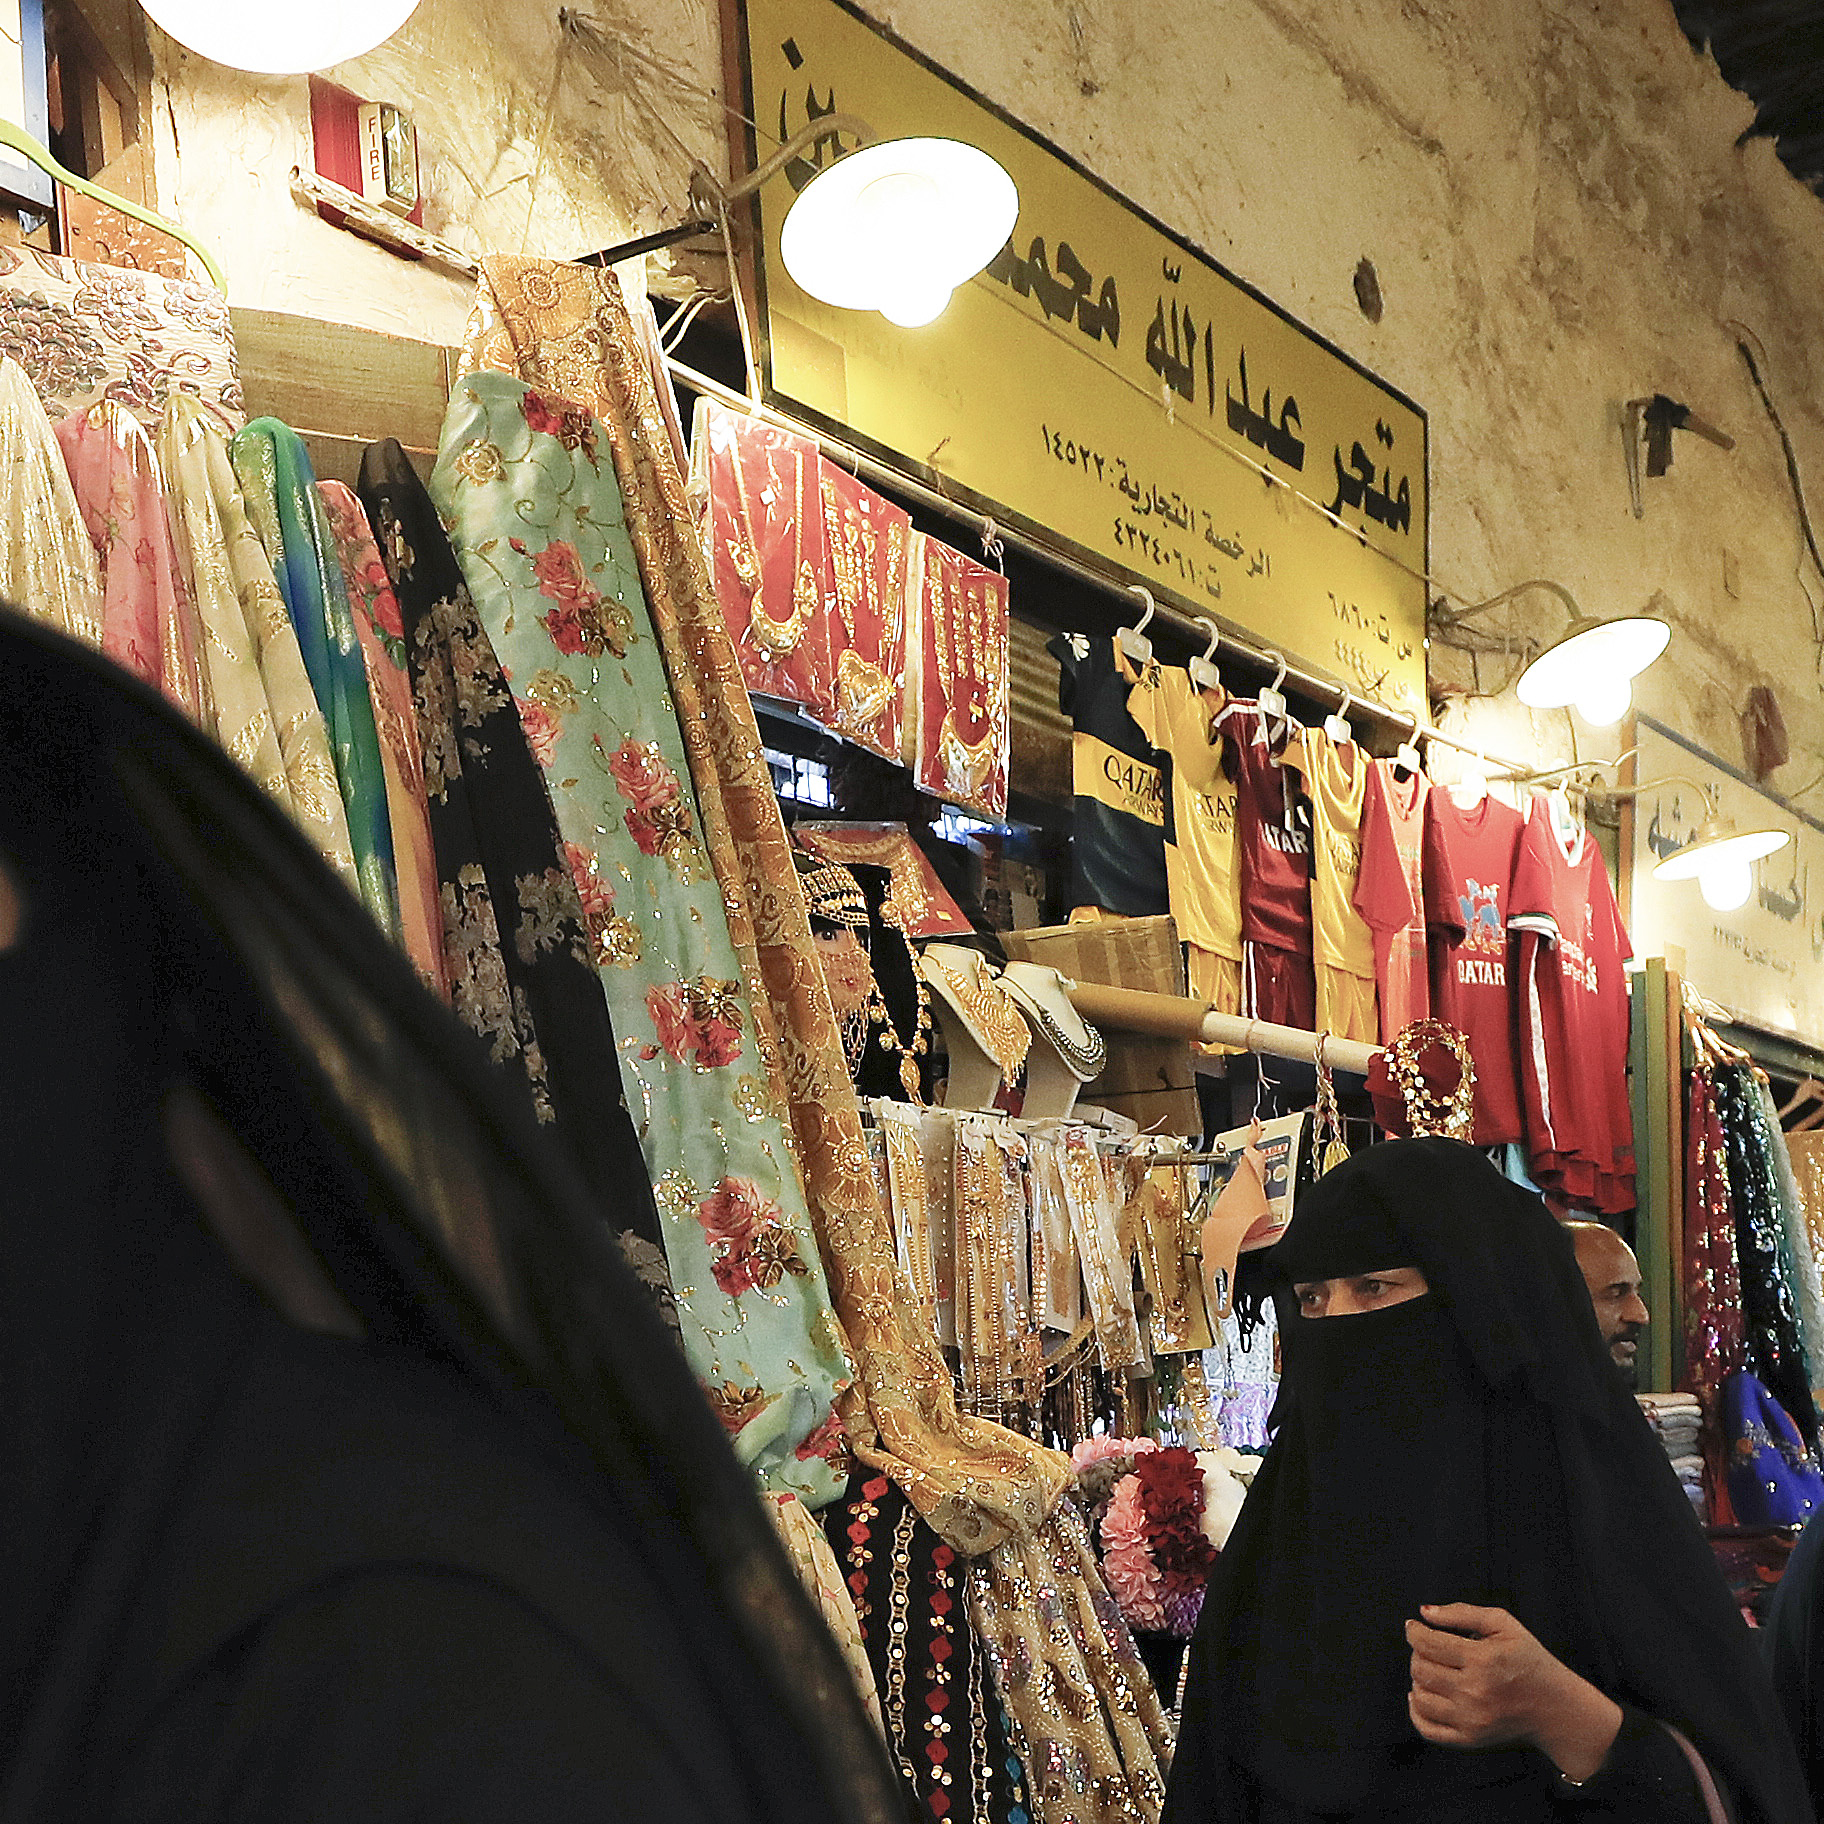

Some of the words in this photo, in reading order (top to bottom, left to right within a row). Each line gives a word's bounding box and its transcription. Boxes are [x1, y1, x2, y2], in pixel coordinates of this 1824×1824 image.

[368, 115, 380, 181] FIRE
[1321, 417, 1411, 549] متجر
[1104, 755, 1164, 801] QATAR
[1457, 959, 1506, 986] QATAR
